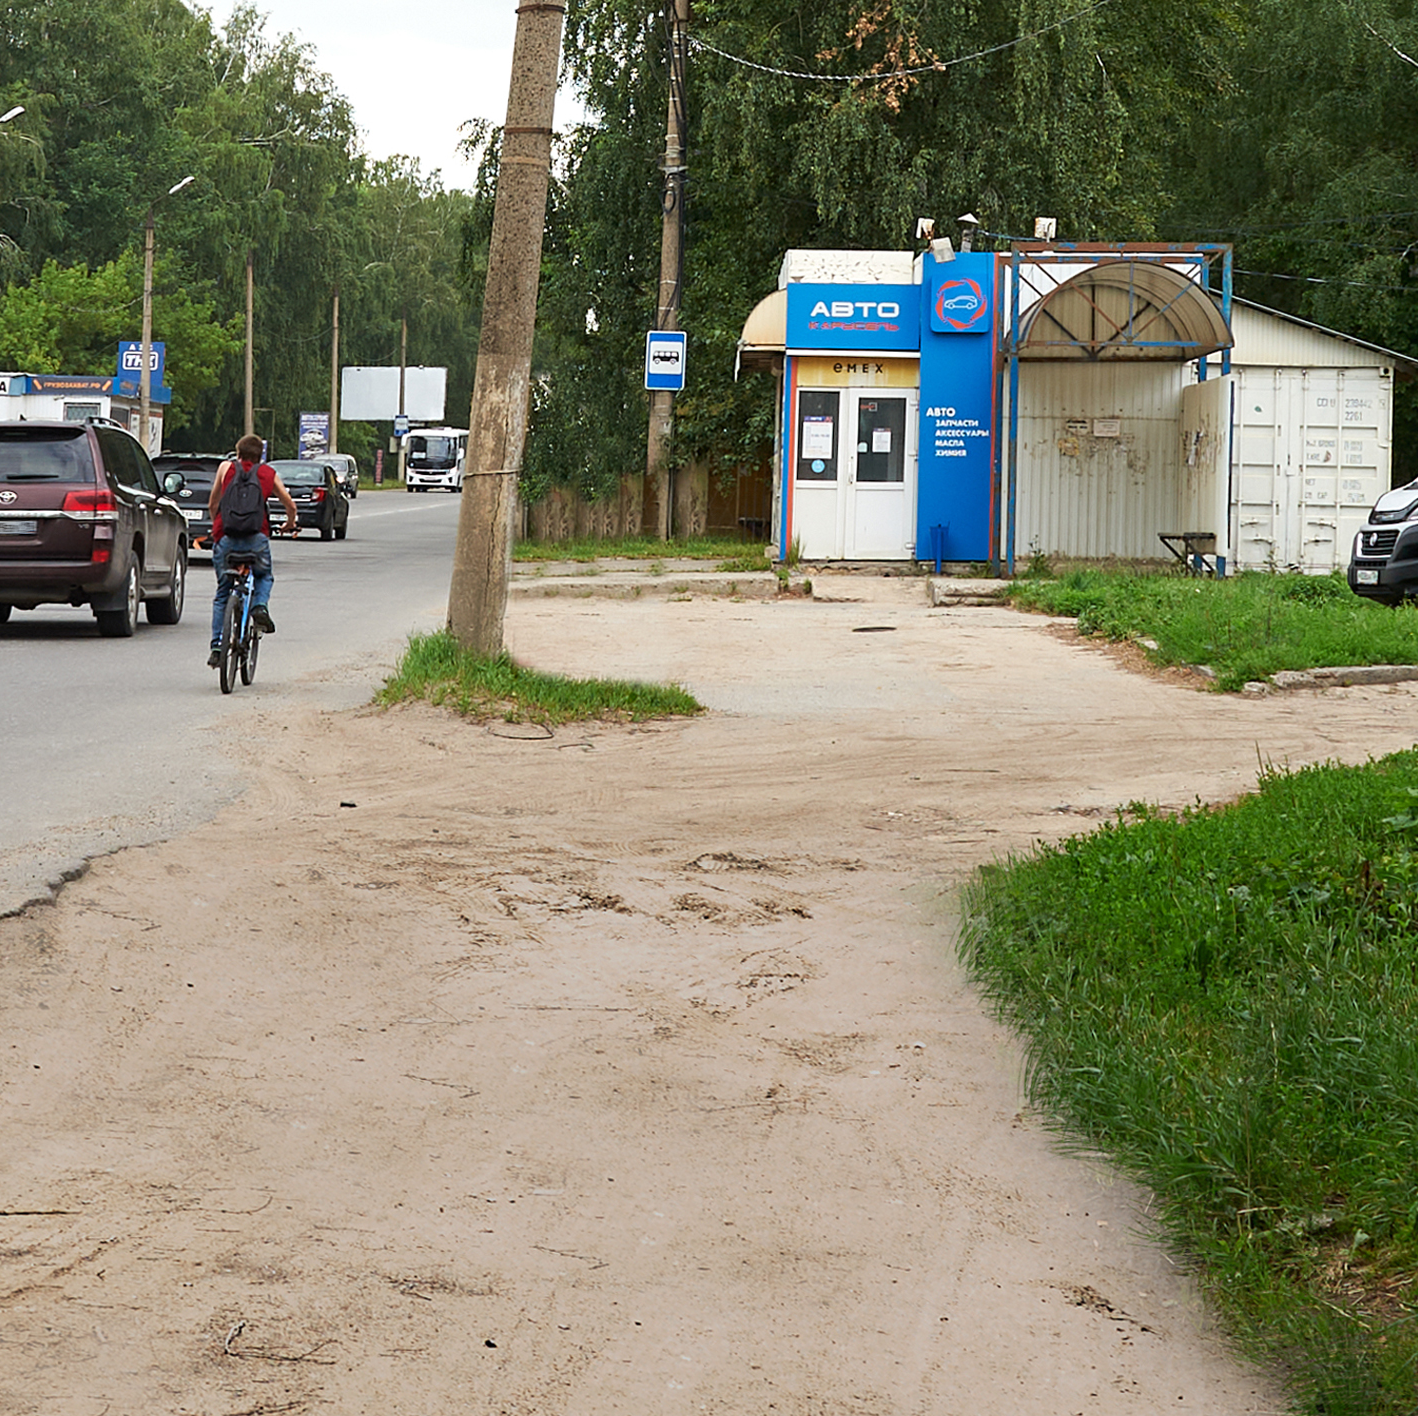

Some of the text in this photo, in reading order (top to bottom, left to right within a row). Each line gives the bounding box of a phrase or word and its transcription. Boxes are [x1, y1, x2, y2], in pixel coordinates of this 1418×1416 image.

[810, 301, 900, 318] АВТО
[926, 407, 956, 417] АВТО
[935, 419, 979, 427] ЗАПЧАСТИ
[935, 429, 990, 437] АКСЕССУАРЫ
[935, 439, 965, 447] МАСЛА
